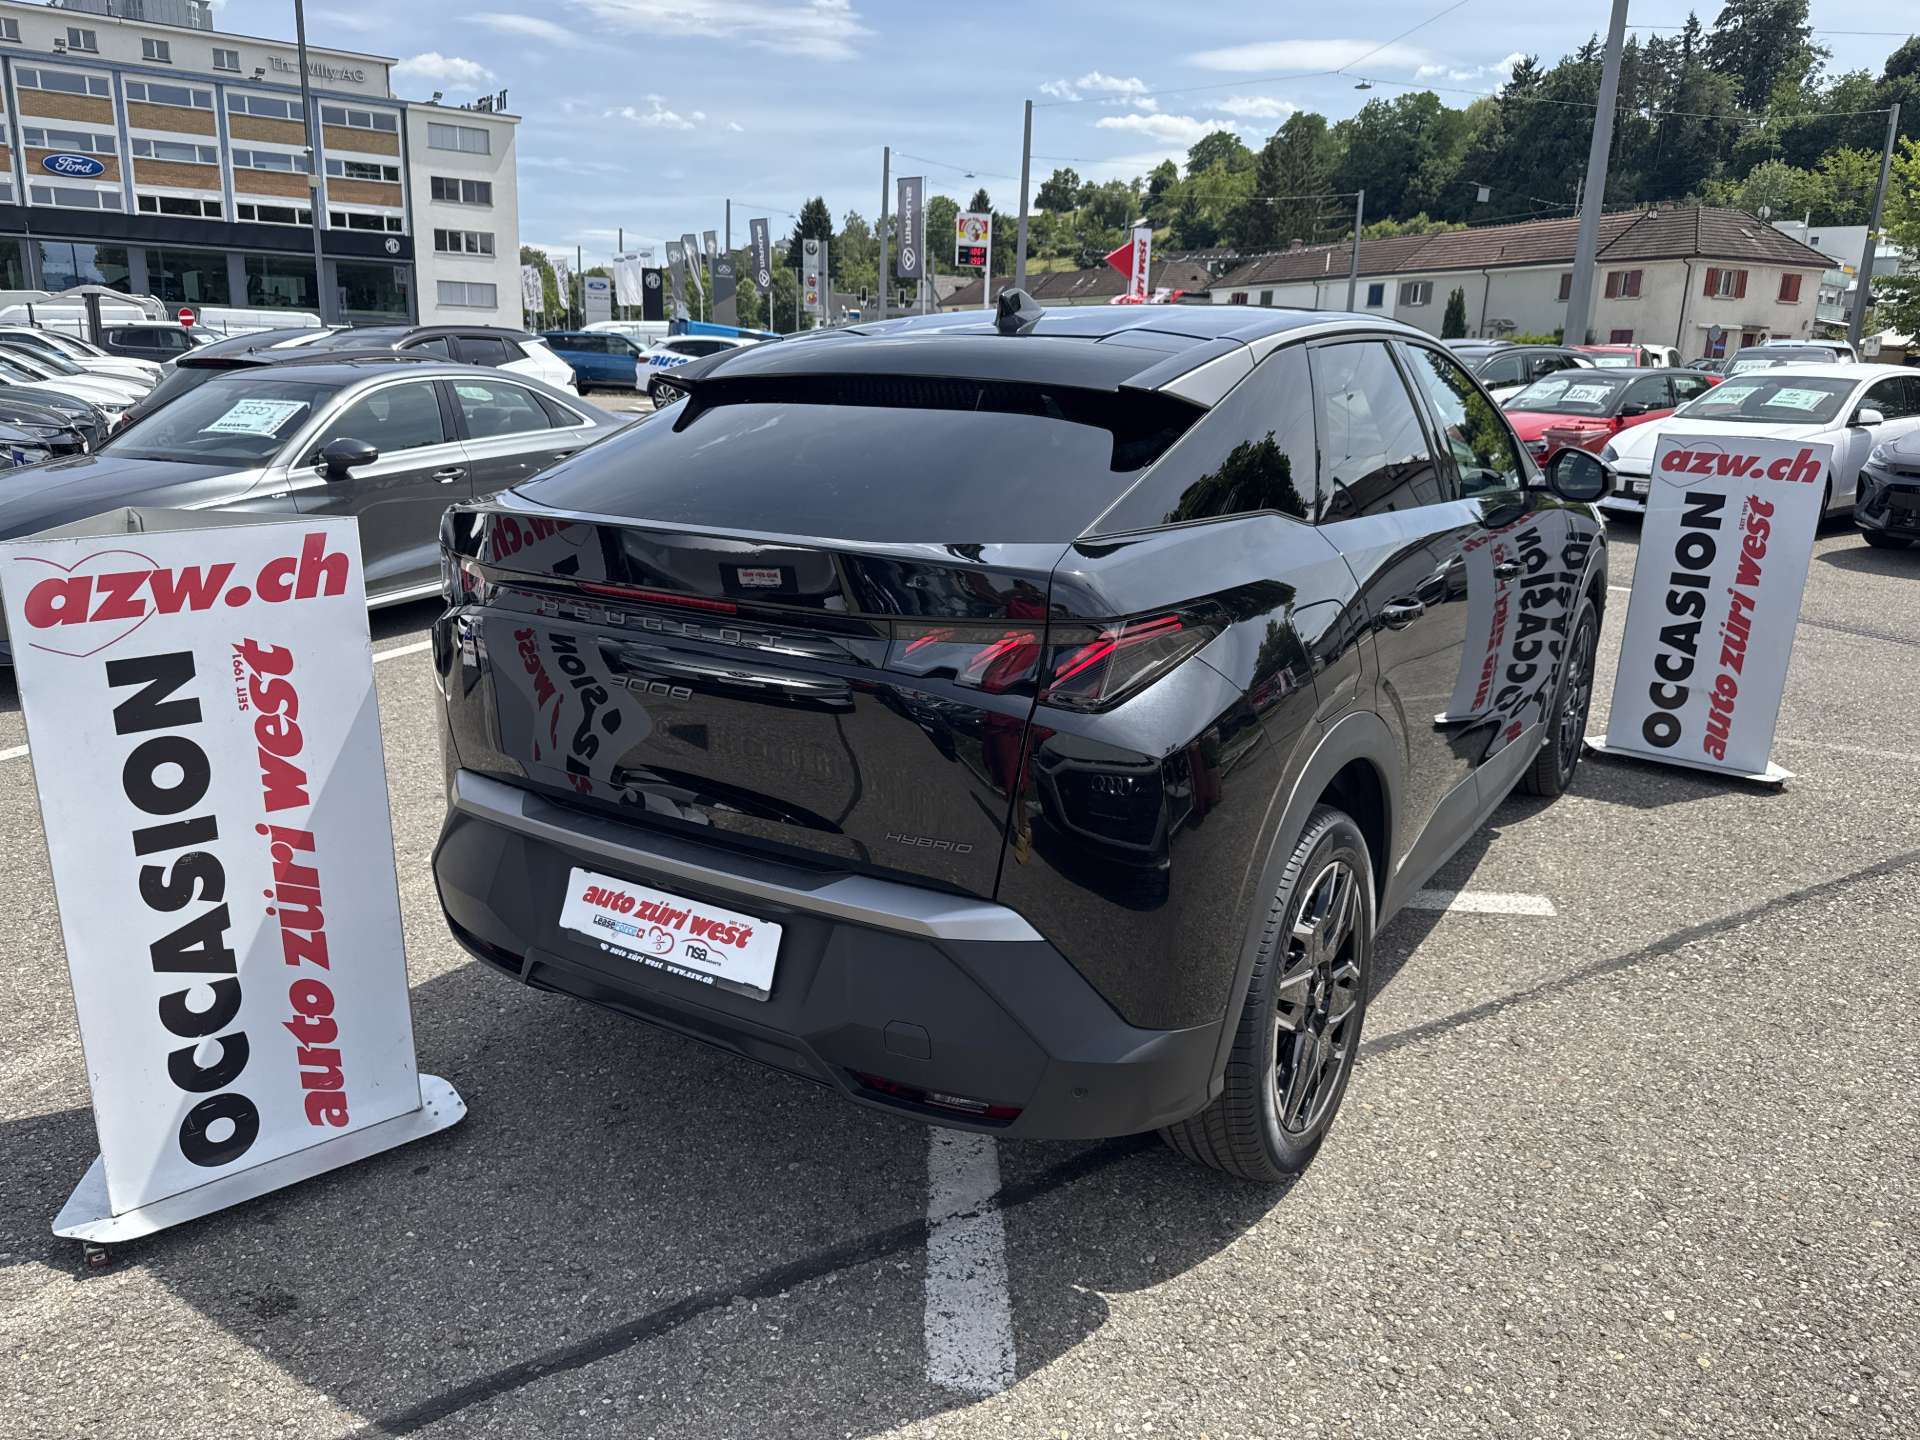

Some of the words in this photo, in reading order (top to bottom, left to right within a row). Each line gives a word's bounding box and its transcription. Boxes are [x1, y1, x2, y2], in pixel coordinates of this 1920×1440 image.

[341, 67, 365, 82] AG
[55, 156, 93, 173] Ford
[1661, 448, 1822, 483] azw.ch
[1735, 494, 1775, 587] west
[24, 532, 349, 629] azw.ch
[541, 600, 782, 648] PEUGEOT
[1642, 491, 1727, 748] OCCASION
[1718, 587, 1757, 676] züri
[233, 653, 245, 683] 1991
[609, 674, 694, 701] 3008
[231, 637, 310, 813] west
[237, 686, 249, 712] SEIT
[1704, 673, 1738, 761] auto
[885, 832, 974, 853] HYBRID
[105, 650, 260, 1168] OCCASION
[255, 822, 331, 971] züri
[582, 885, 636, 914] auto
[632, 900, 691, 930] züri
[689, 914, 753, 949] west
[609, 947, 627, 957] auto
[645, 958, 663, 969] west
[685, 943, 707, 962] nsa
[282, 978, 349, 1128] auto
